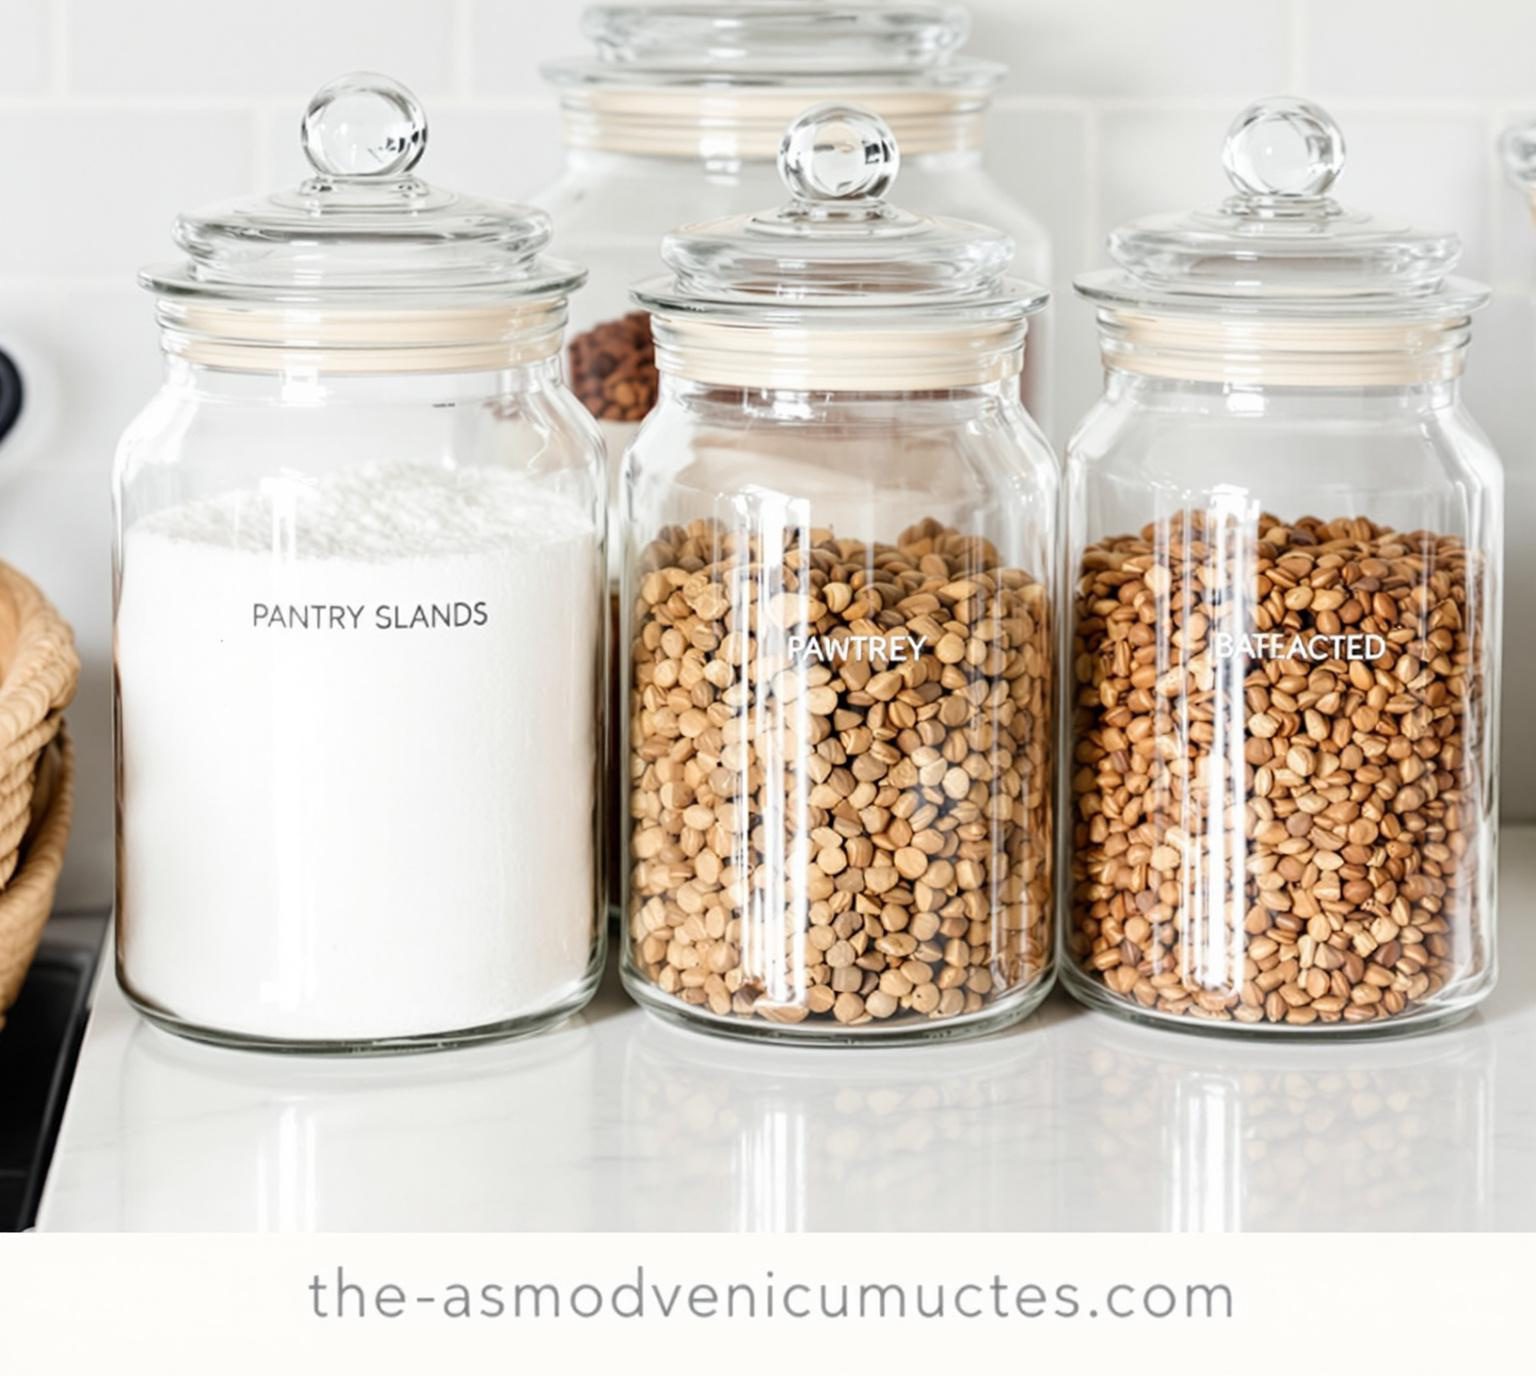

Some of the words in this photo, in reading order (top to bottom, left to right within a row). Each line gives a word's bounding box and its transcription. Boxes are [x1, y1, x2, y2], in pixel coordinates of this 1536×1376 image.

[253, 602, 366, 630] PANTRY
[375, 601, 489, 630] SLANDS
[787, 635, 928, 662] PAWTREY
